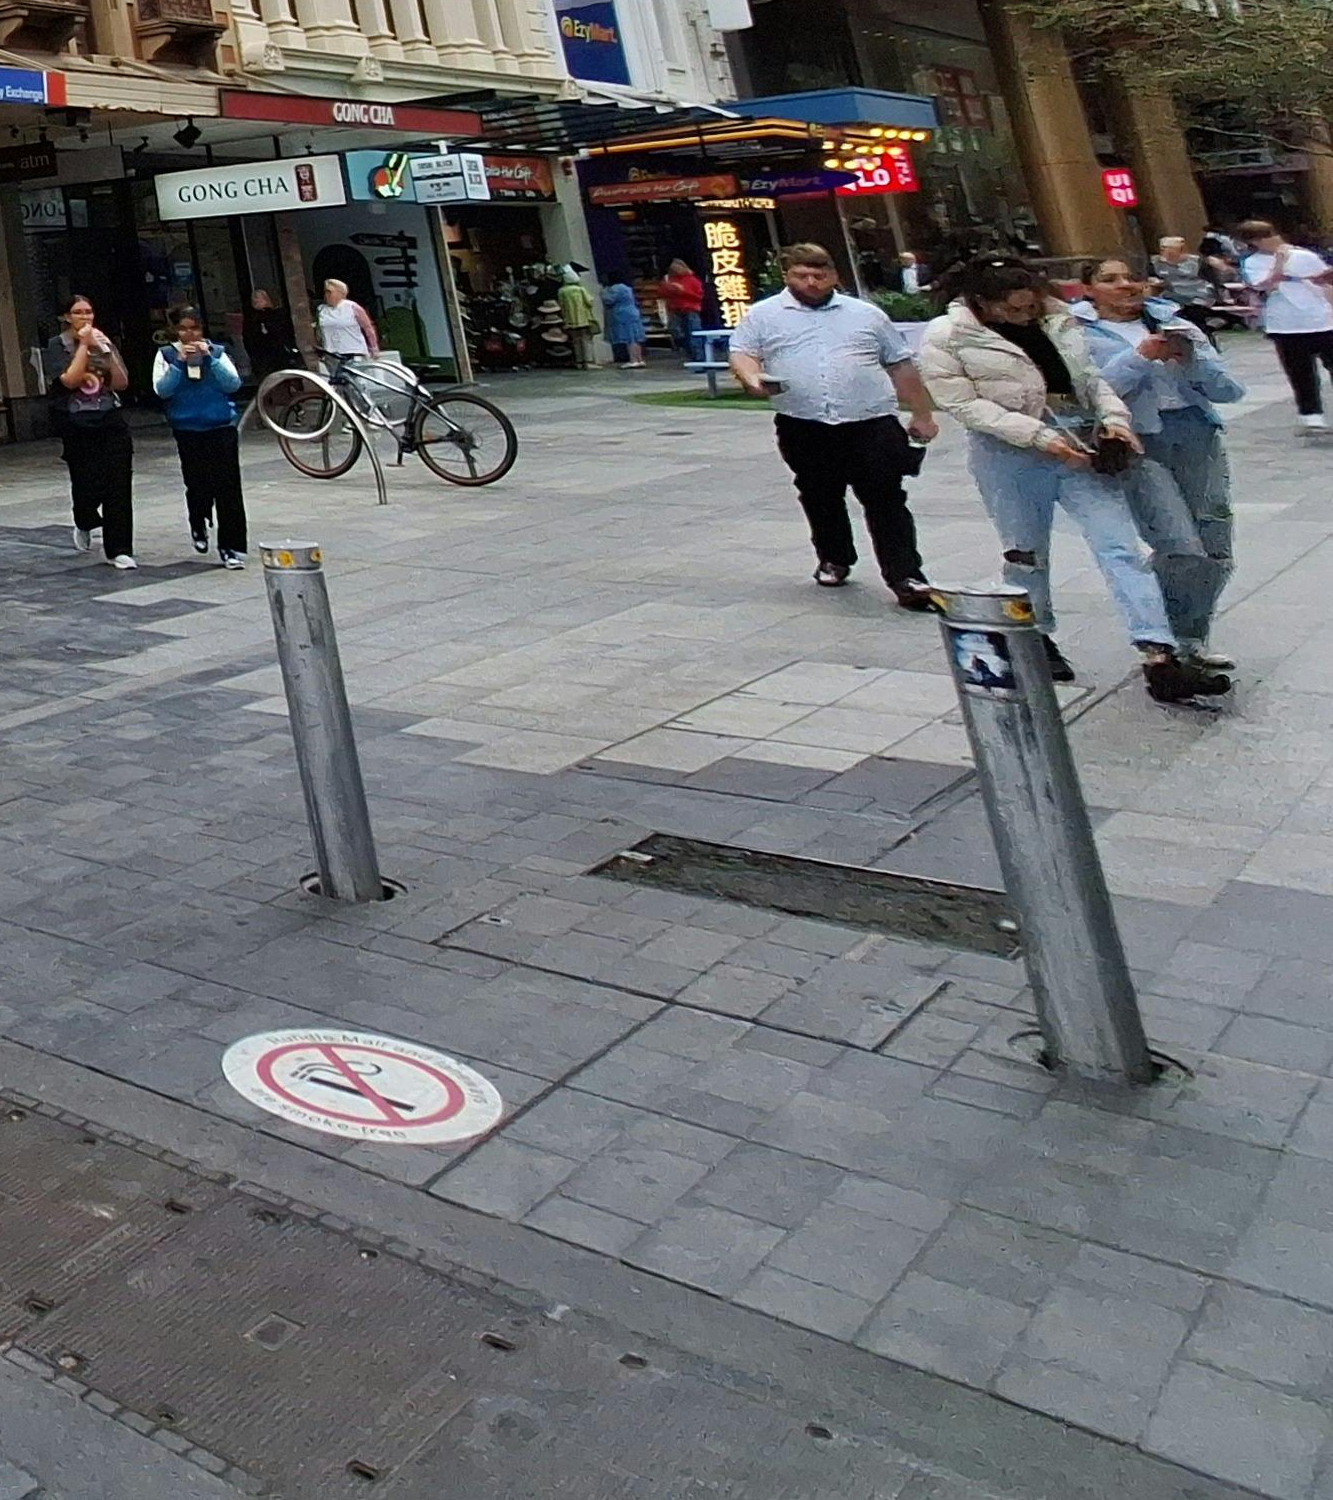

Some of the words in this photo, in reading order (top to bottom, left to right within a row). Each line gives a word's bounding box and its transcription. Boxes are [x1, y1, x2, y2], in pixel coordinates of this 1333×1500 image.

[5, 85, 44, 102] Exchange
[333, 102, 368, 123] GONG
[370, 105, 395, 125] CHA
[20, 153, 50, 170] atm
[178, 180, 238, 204] GONG
[243, 176, 290, 198] CHA
